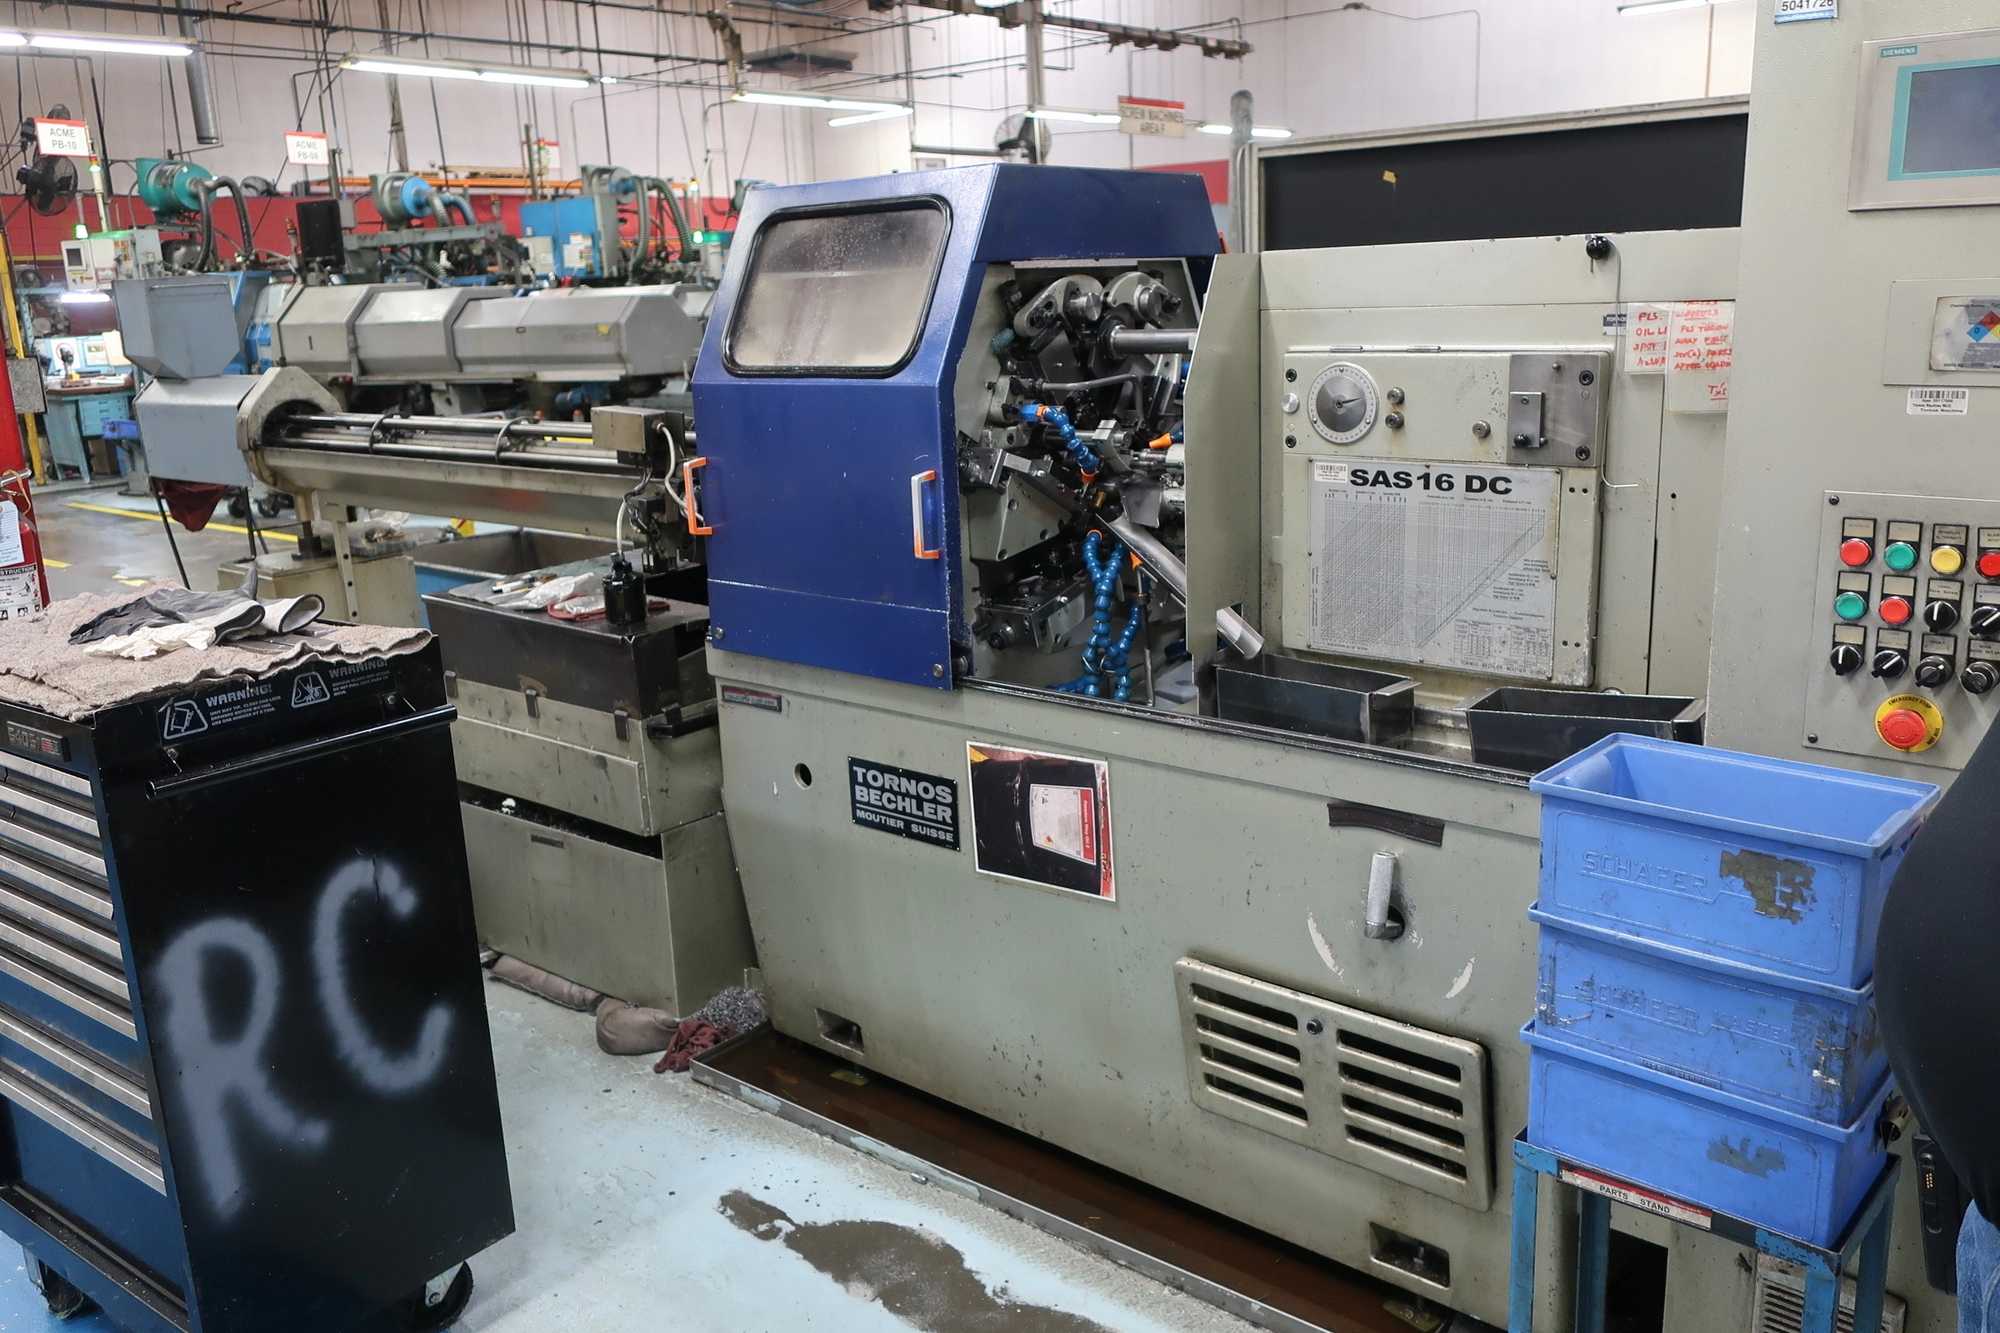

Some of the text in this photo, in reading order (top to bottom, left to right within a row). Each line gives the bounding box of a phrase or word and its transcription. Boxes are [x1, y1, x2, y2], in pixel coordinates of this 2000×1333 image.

[50, 127, 77, 138] ACME
[1464, 474, 1513, 496] DC
[206, 683, 273, 708] WARNING!
[853, 766, 953, 804] TORNOS
[855, 785, 953, 824] BECHLER
[856, 809, 954, 842] MOUTIER SUISSE
[1600, 1184, 1670, 1214] PARTS STAND
